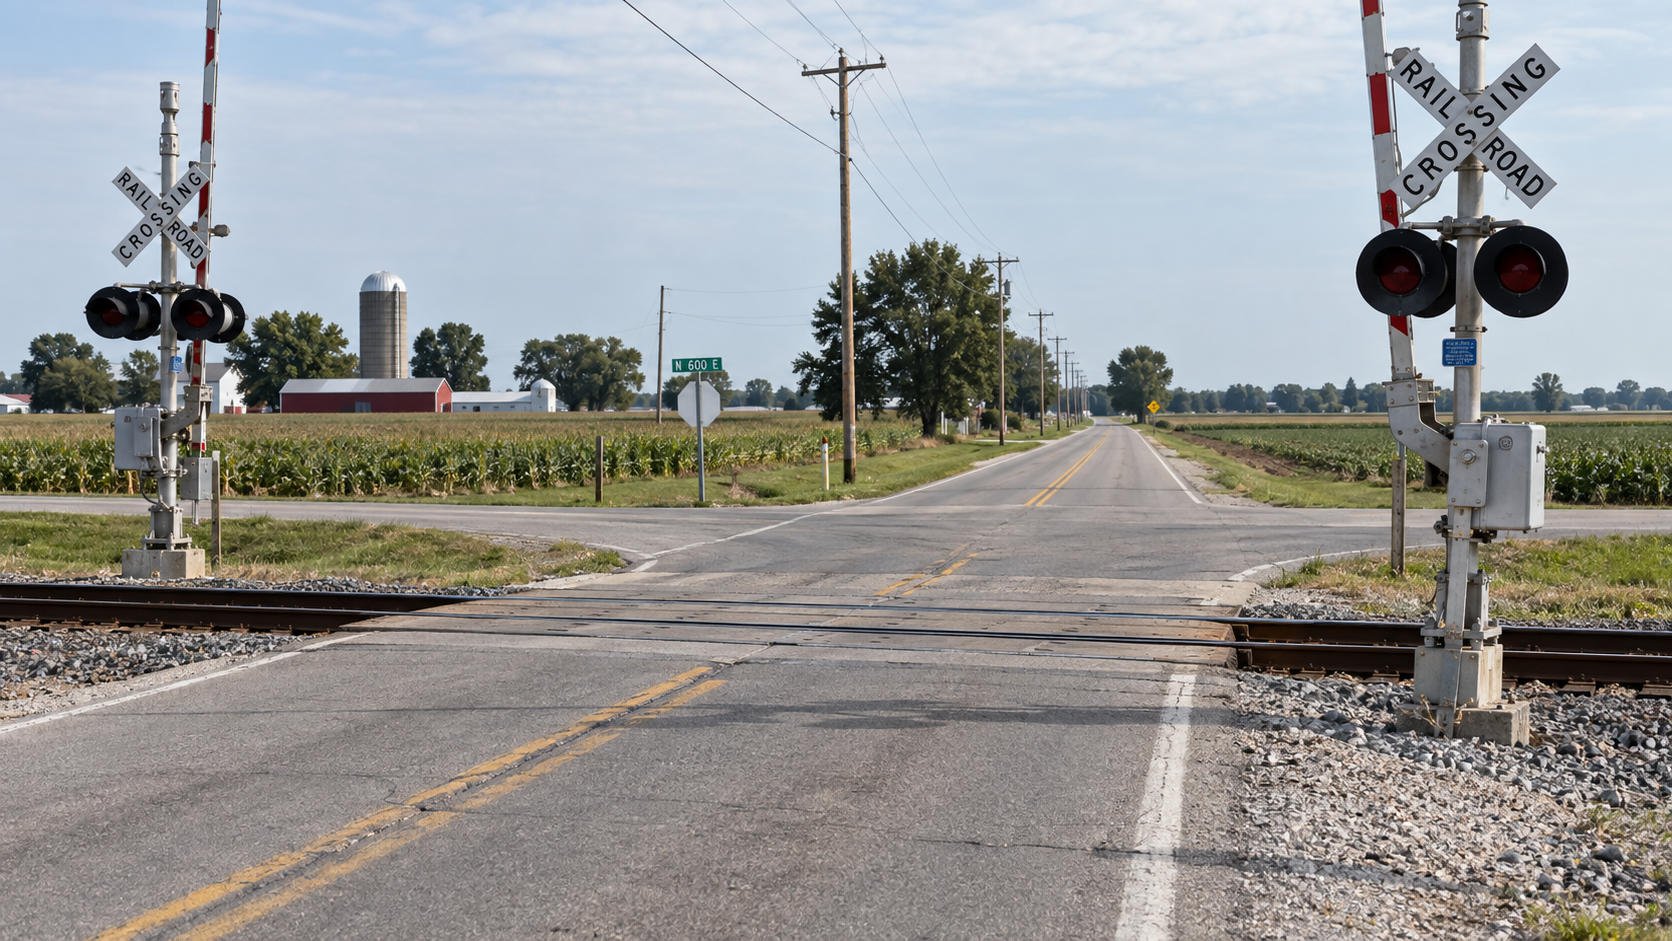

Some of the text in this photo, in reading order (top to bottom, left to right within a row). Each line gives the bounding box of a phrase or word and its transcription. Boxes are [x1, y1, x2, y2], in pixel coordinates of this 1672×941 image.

[1399, 58, 1544, 197] RAIL ROAD
[1402, 57, 1546, 196] CROSSING
[117, 172, 204, 259] RAIL ROAD
[119, 172, 202, 259] CROSSING
[675, 359, 719, 371] N 600 E
